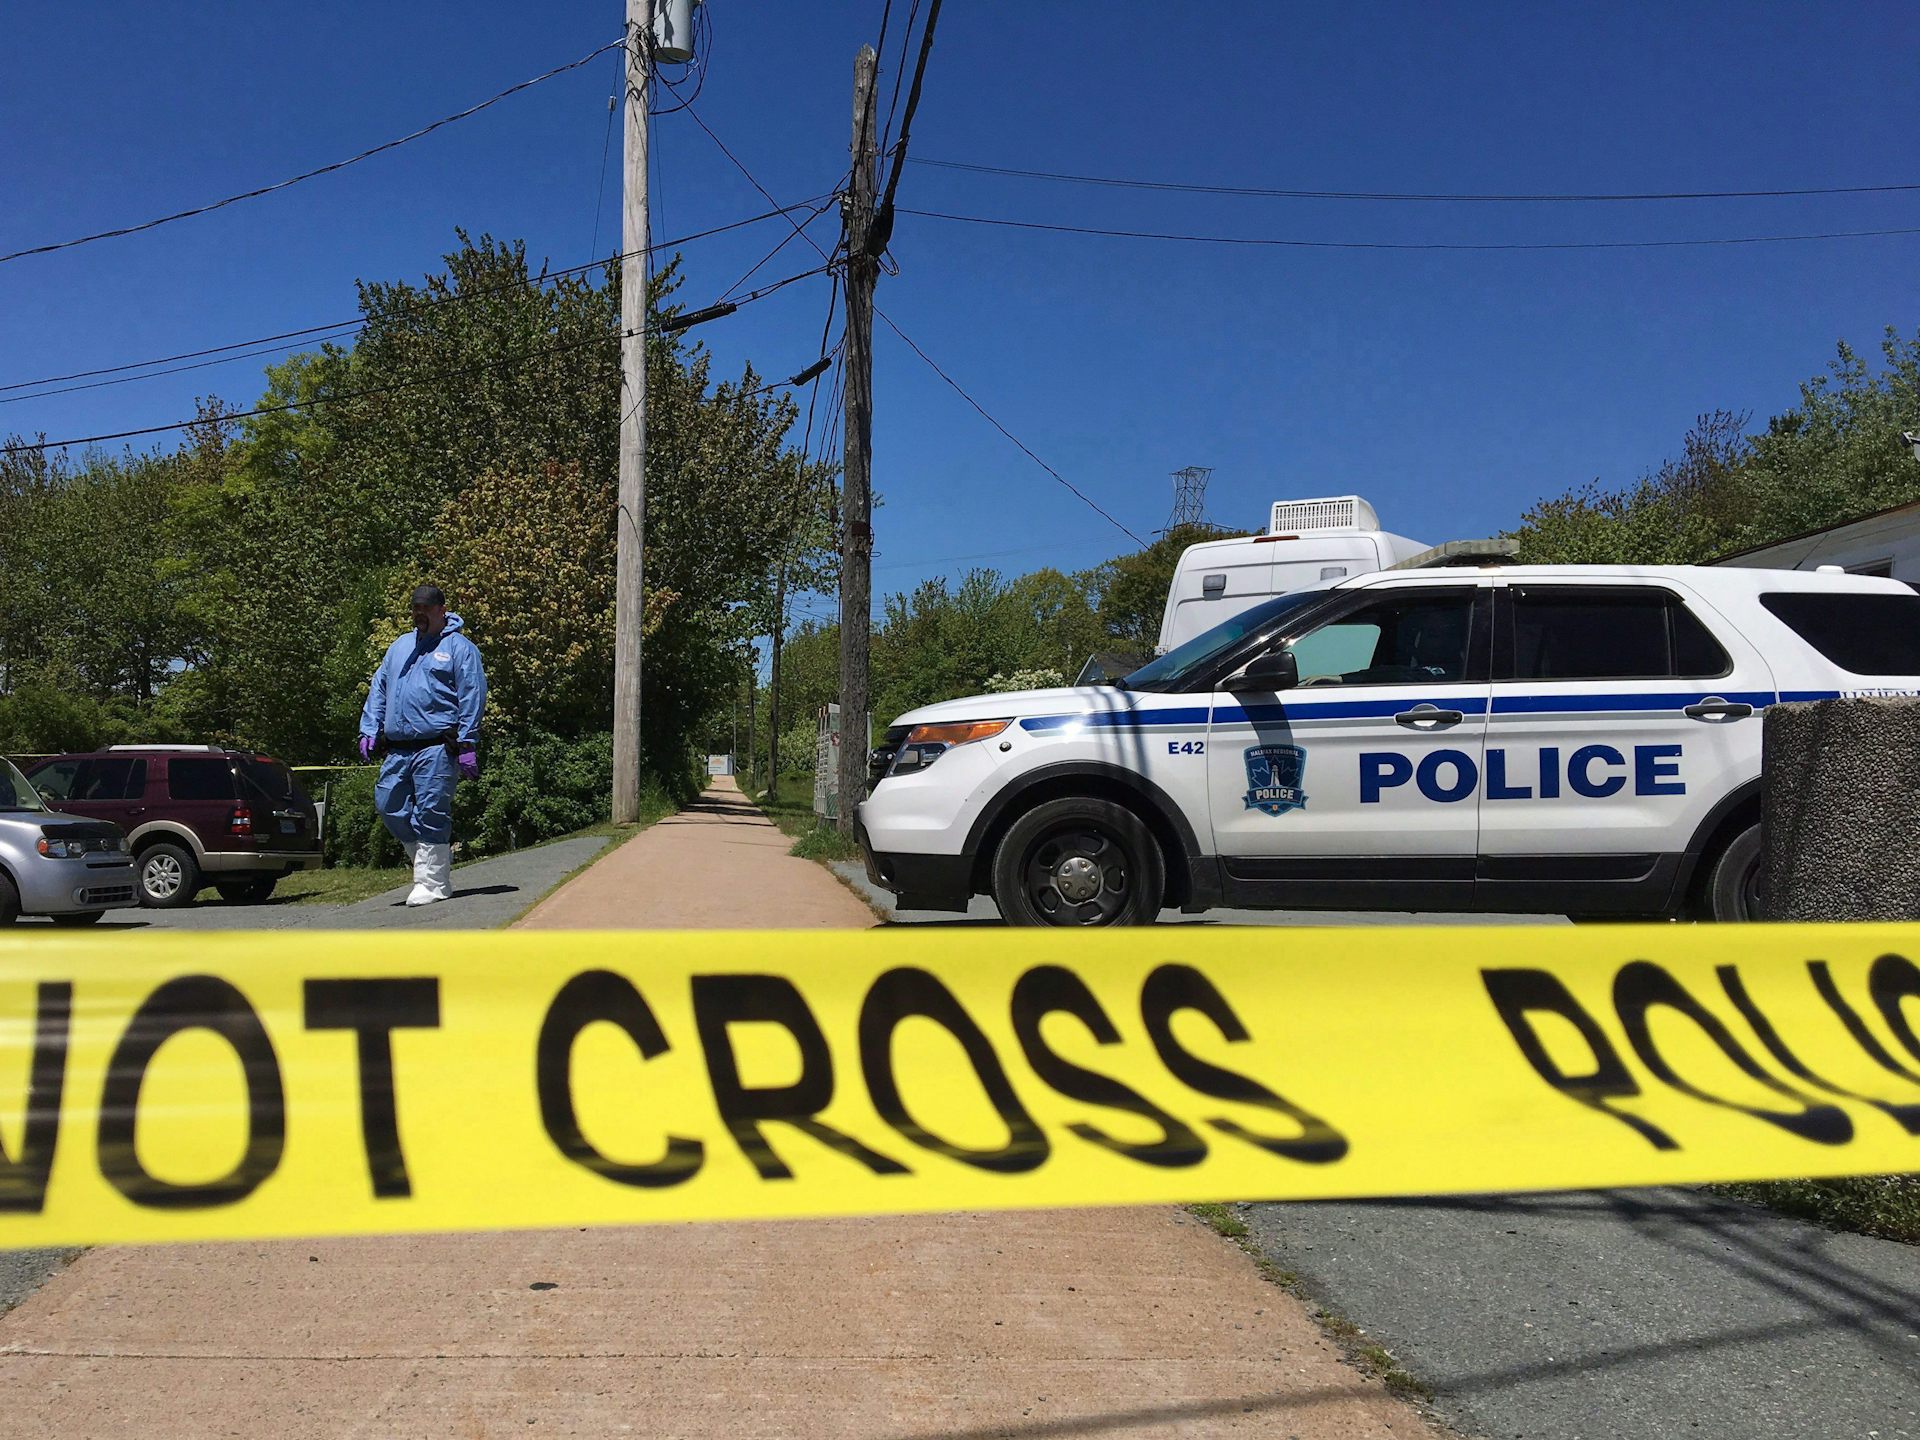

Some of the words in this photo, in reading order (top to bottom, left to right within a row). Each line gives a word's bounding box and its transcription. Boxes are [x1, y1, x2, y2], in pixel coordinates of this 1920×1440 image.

[1168, 741, 1204, 755] E42
[1359, 744, 1686, 803] POLICE
[1255, 788, 1295, 800] POLICE
[536, 963, 1350, 1189] CROSS
[1479, 953, 1920, 1151] POLI
